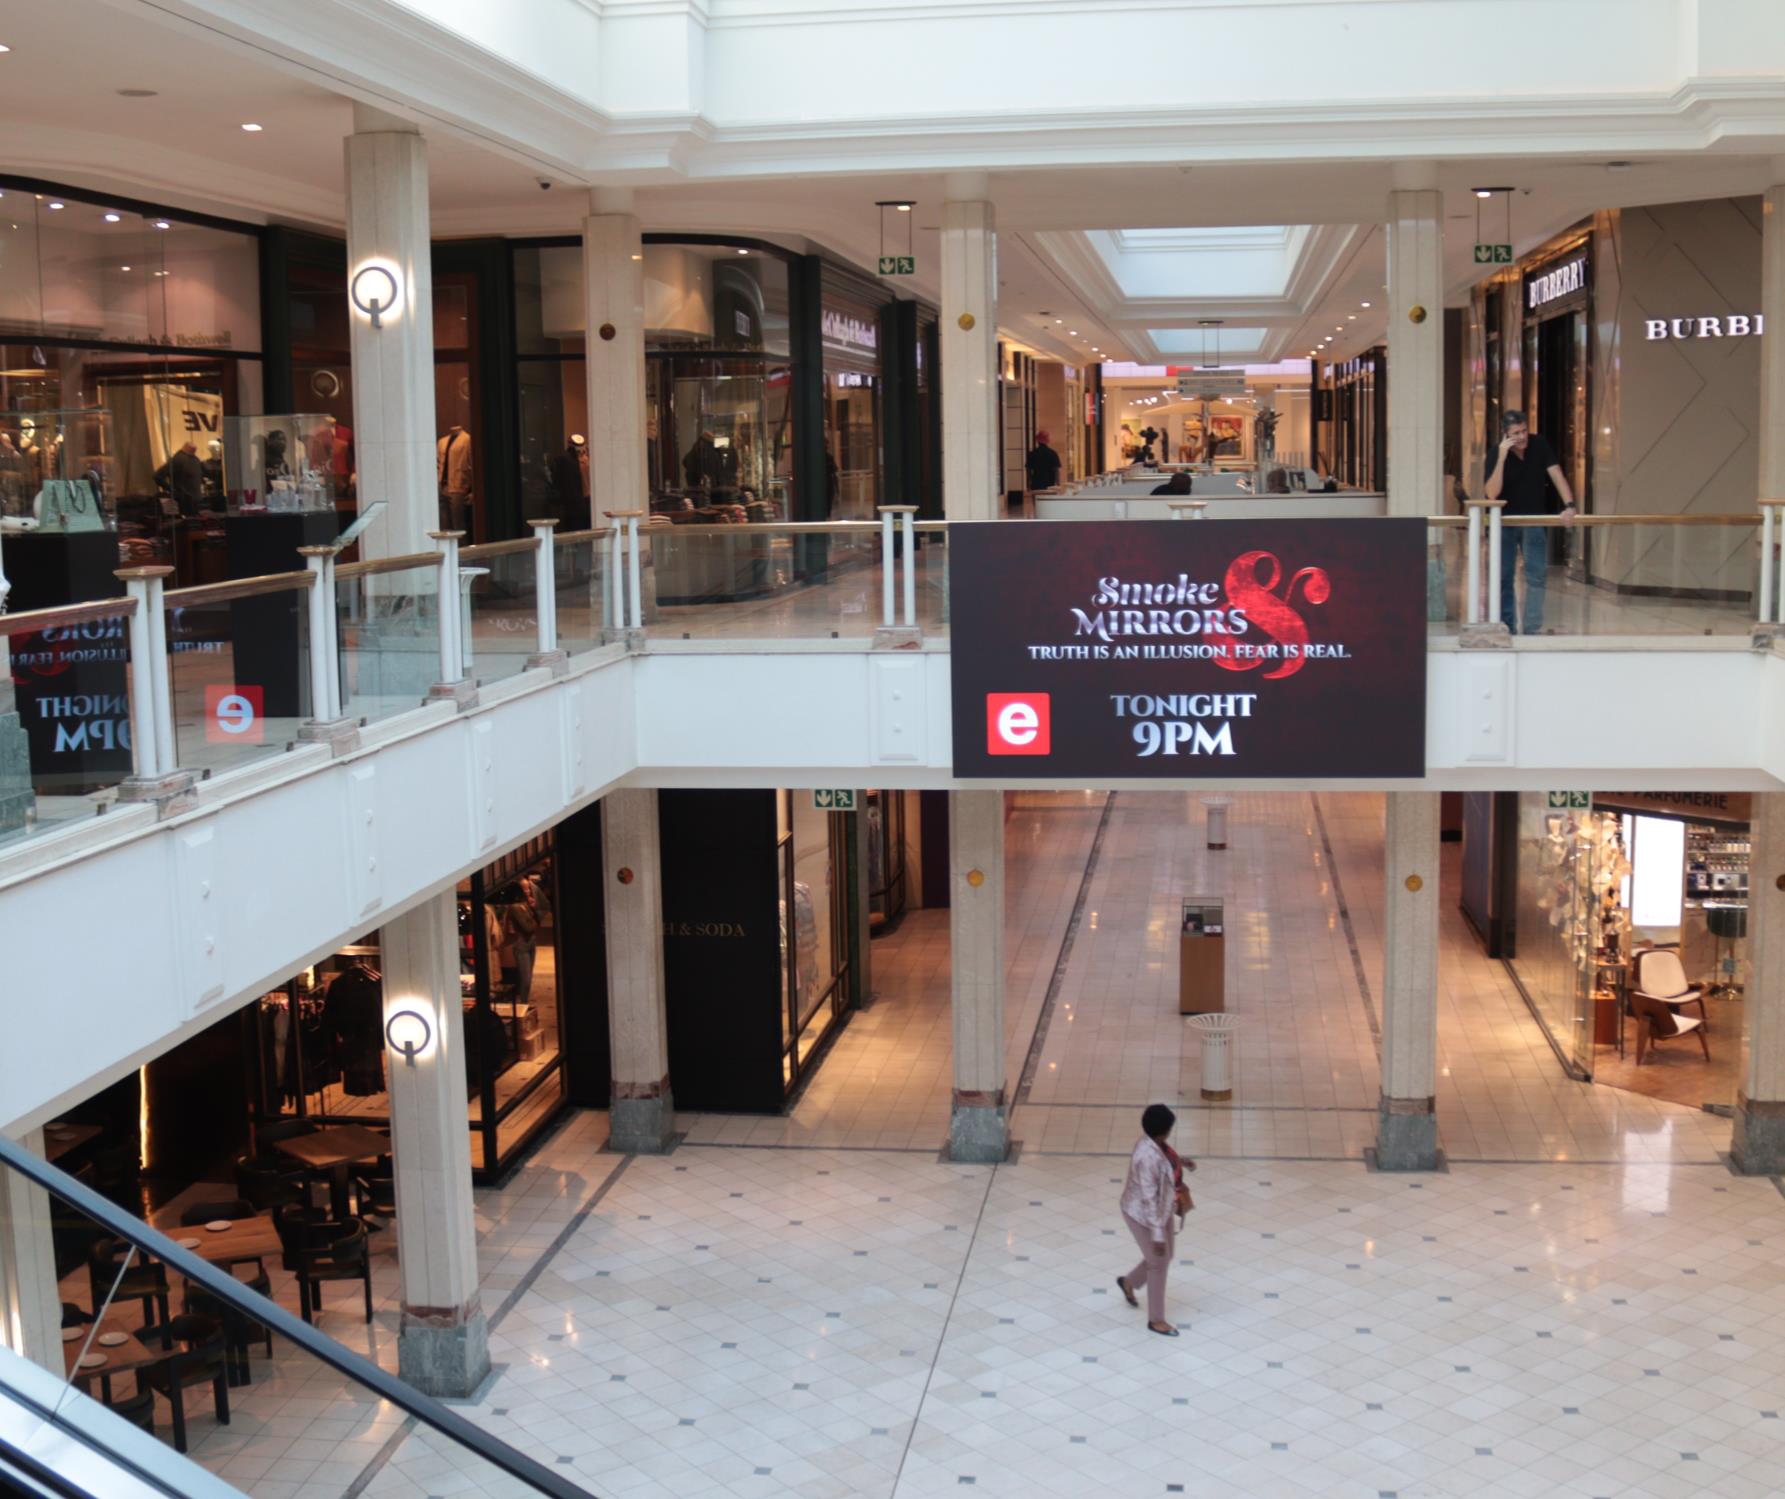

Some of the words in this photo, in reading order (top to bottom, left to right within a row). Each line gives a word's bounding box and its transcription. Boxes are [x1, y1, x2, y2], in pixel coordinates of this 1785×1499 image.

[1529, 257, 1586, 308] BURBERRY
[1092, 574, 1219, 607] Smoke
[1070, 608, 1249, 641] MIRRORS
[1028, 646, 1089, 660] TRUTH
[1094, 645, 1110, 660] IS
[1113, 645, 1141, 660] AN
[1144, 645, 1231, 659] ILLUSION.
[1235, 645, 1278, 659] FEAR
[1283, 645, 1299, 659] IS
[1303, 644, 1353, 659] REAL.
[1110, 694, 1258, 718] TONIGHT
[998, 703, 1039, 745] e
[1132, 721, 1238, 757] 9PM
[696, 922, 746, 936] SODA
